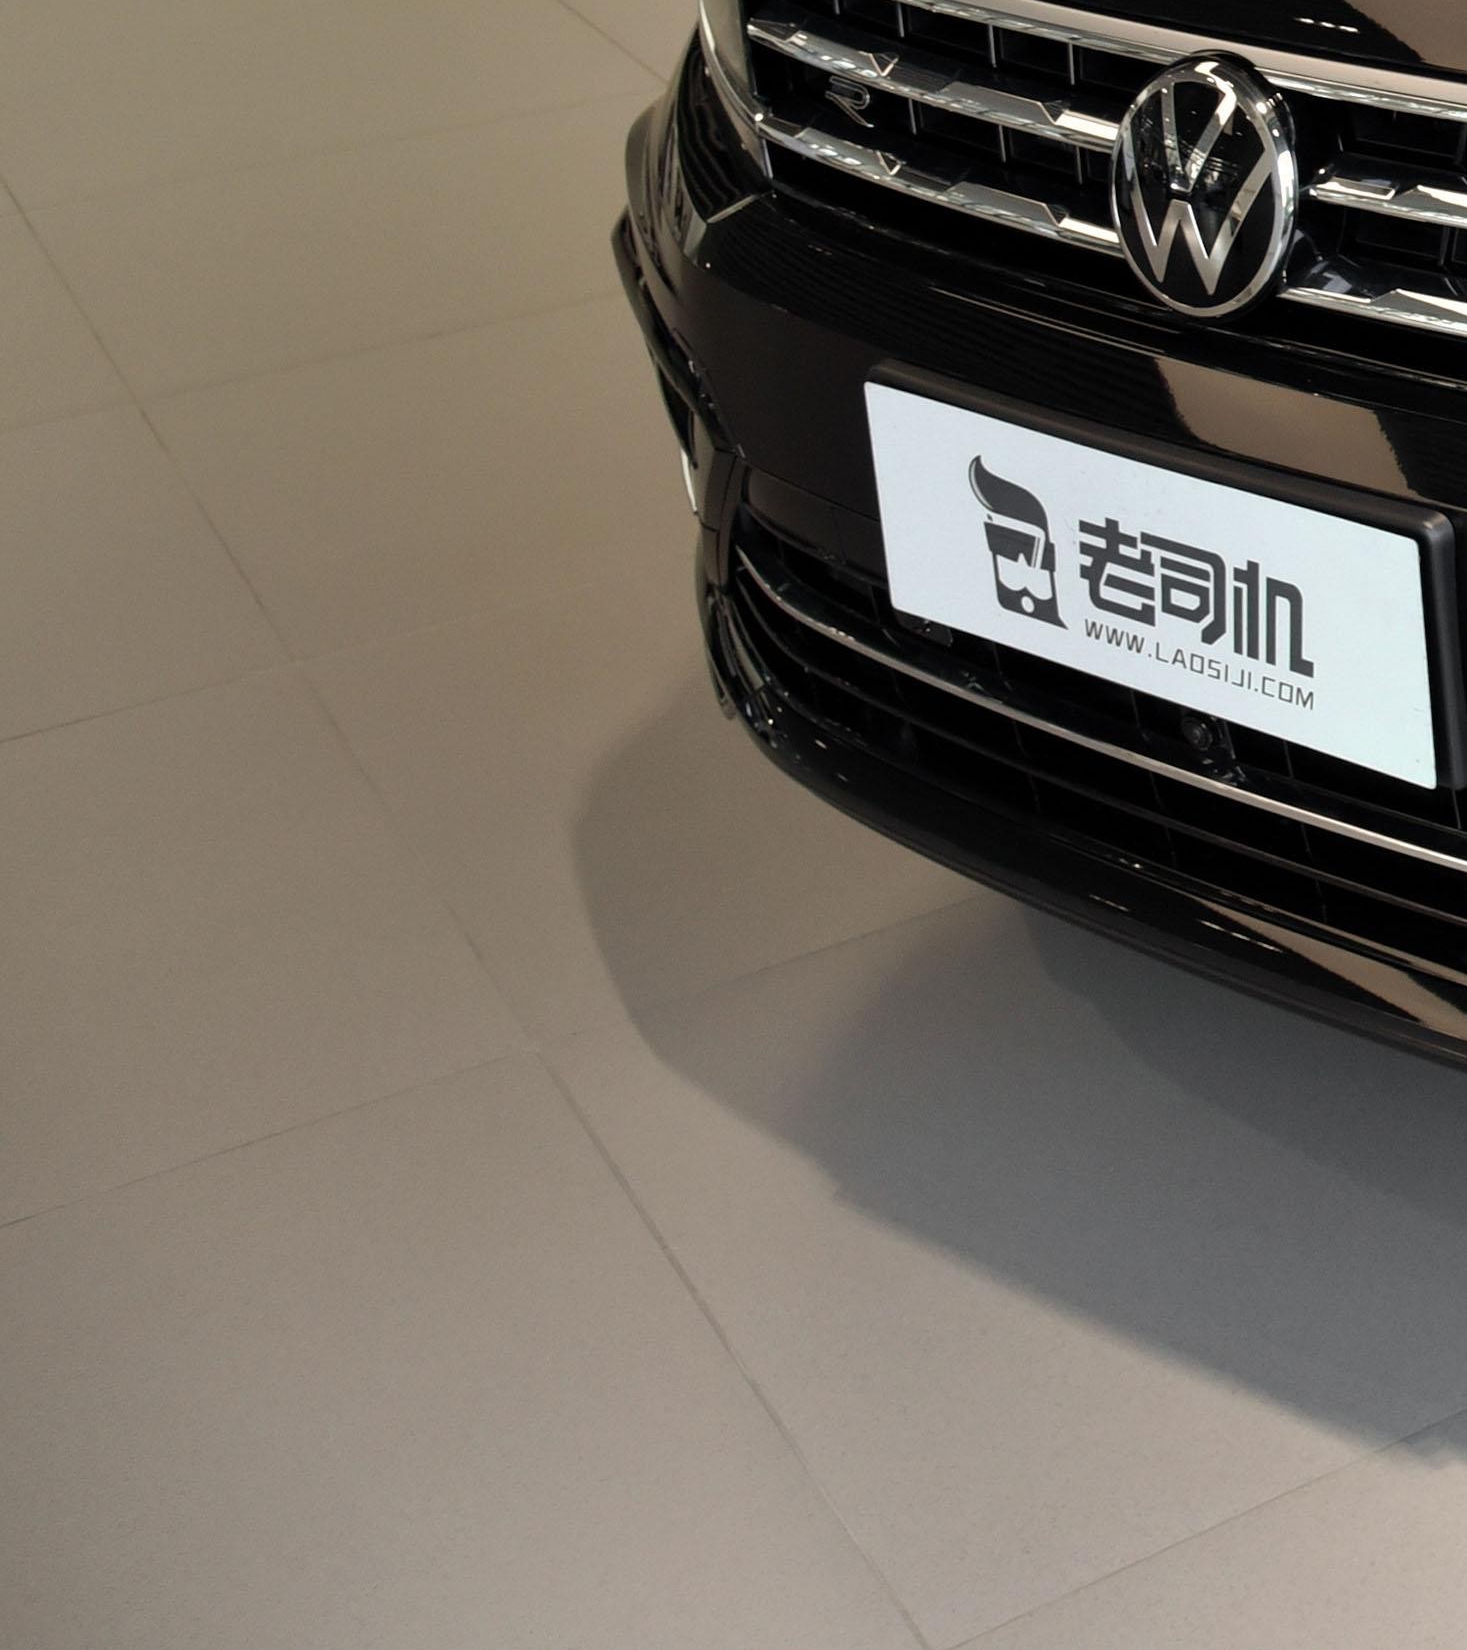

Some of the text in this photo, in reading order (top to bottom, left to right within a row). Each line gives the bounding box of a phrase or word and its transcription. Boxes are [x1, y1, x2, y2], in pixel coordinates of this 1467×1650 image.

[824, 74, 875, 129] R
[1078, 516, 1315, 679] 老司机
[1083, 618, 1315, 711] WWW.LAOSIJI.COM
